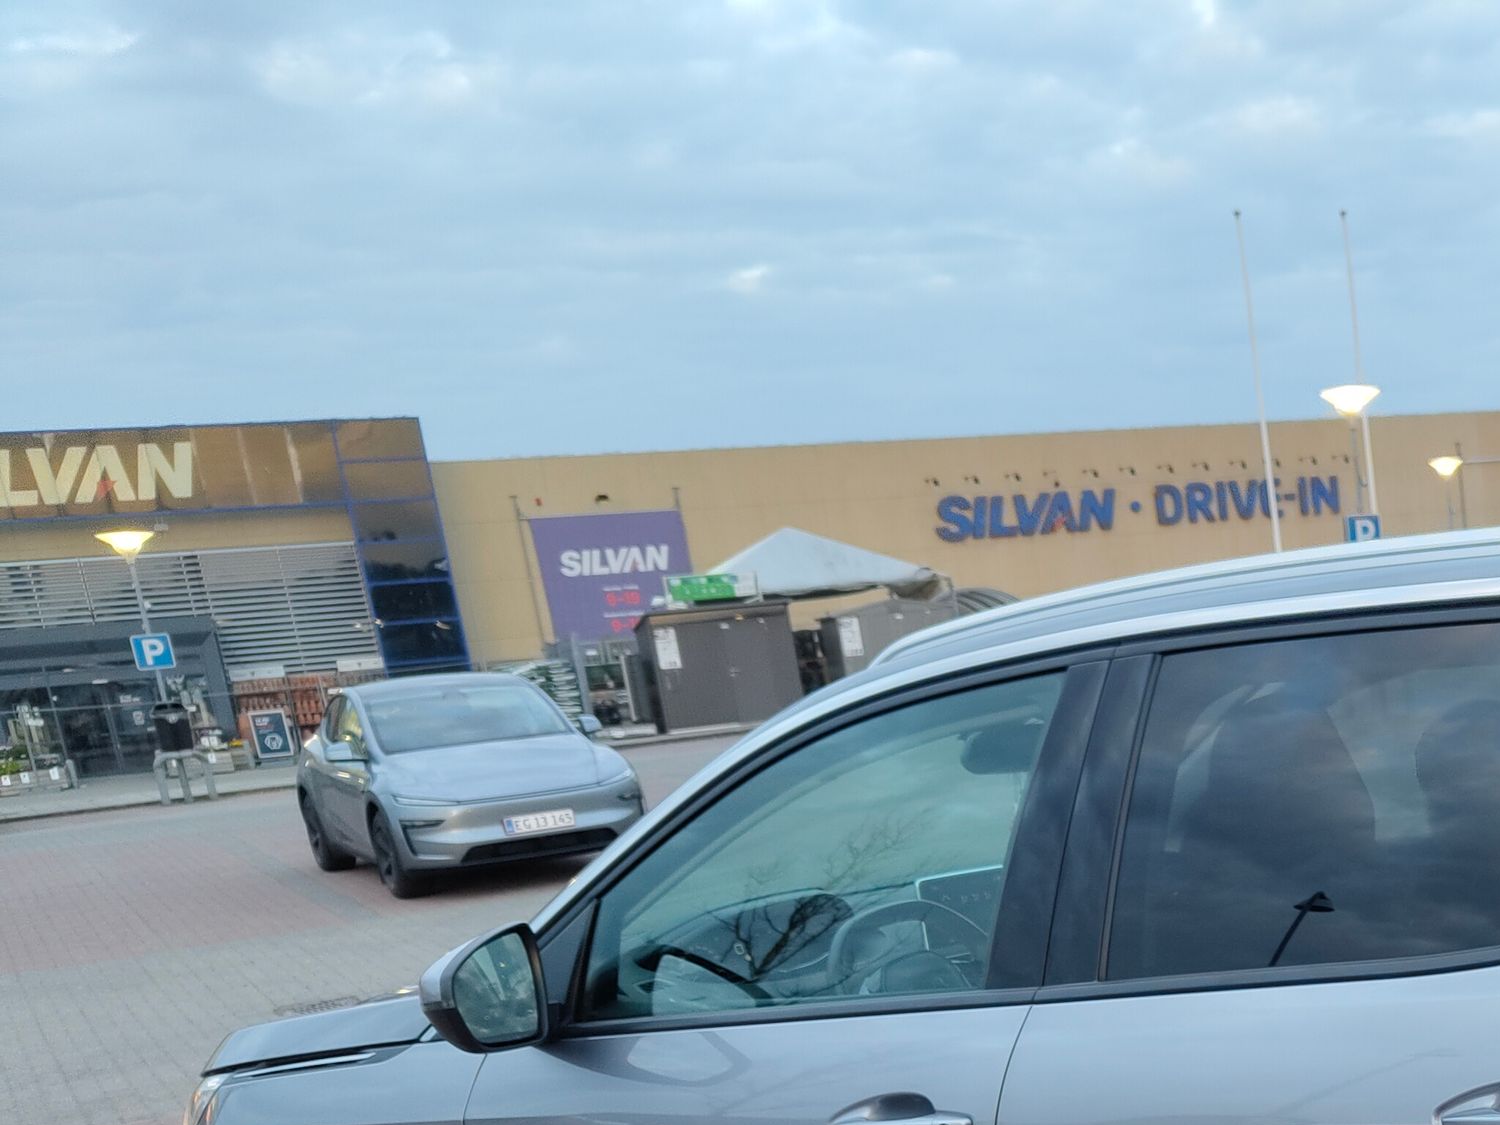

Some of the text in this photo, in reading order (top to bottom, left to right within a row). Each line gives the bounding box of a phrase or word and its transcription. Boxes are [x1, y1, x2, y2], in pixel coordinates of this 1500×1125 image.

[936, 475, 1341, 543] SILVAN DRIVE-IN
[560, 545, 669, 578] SILVAN
[141, 639, 164, 666] P
